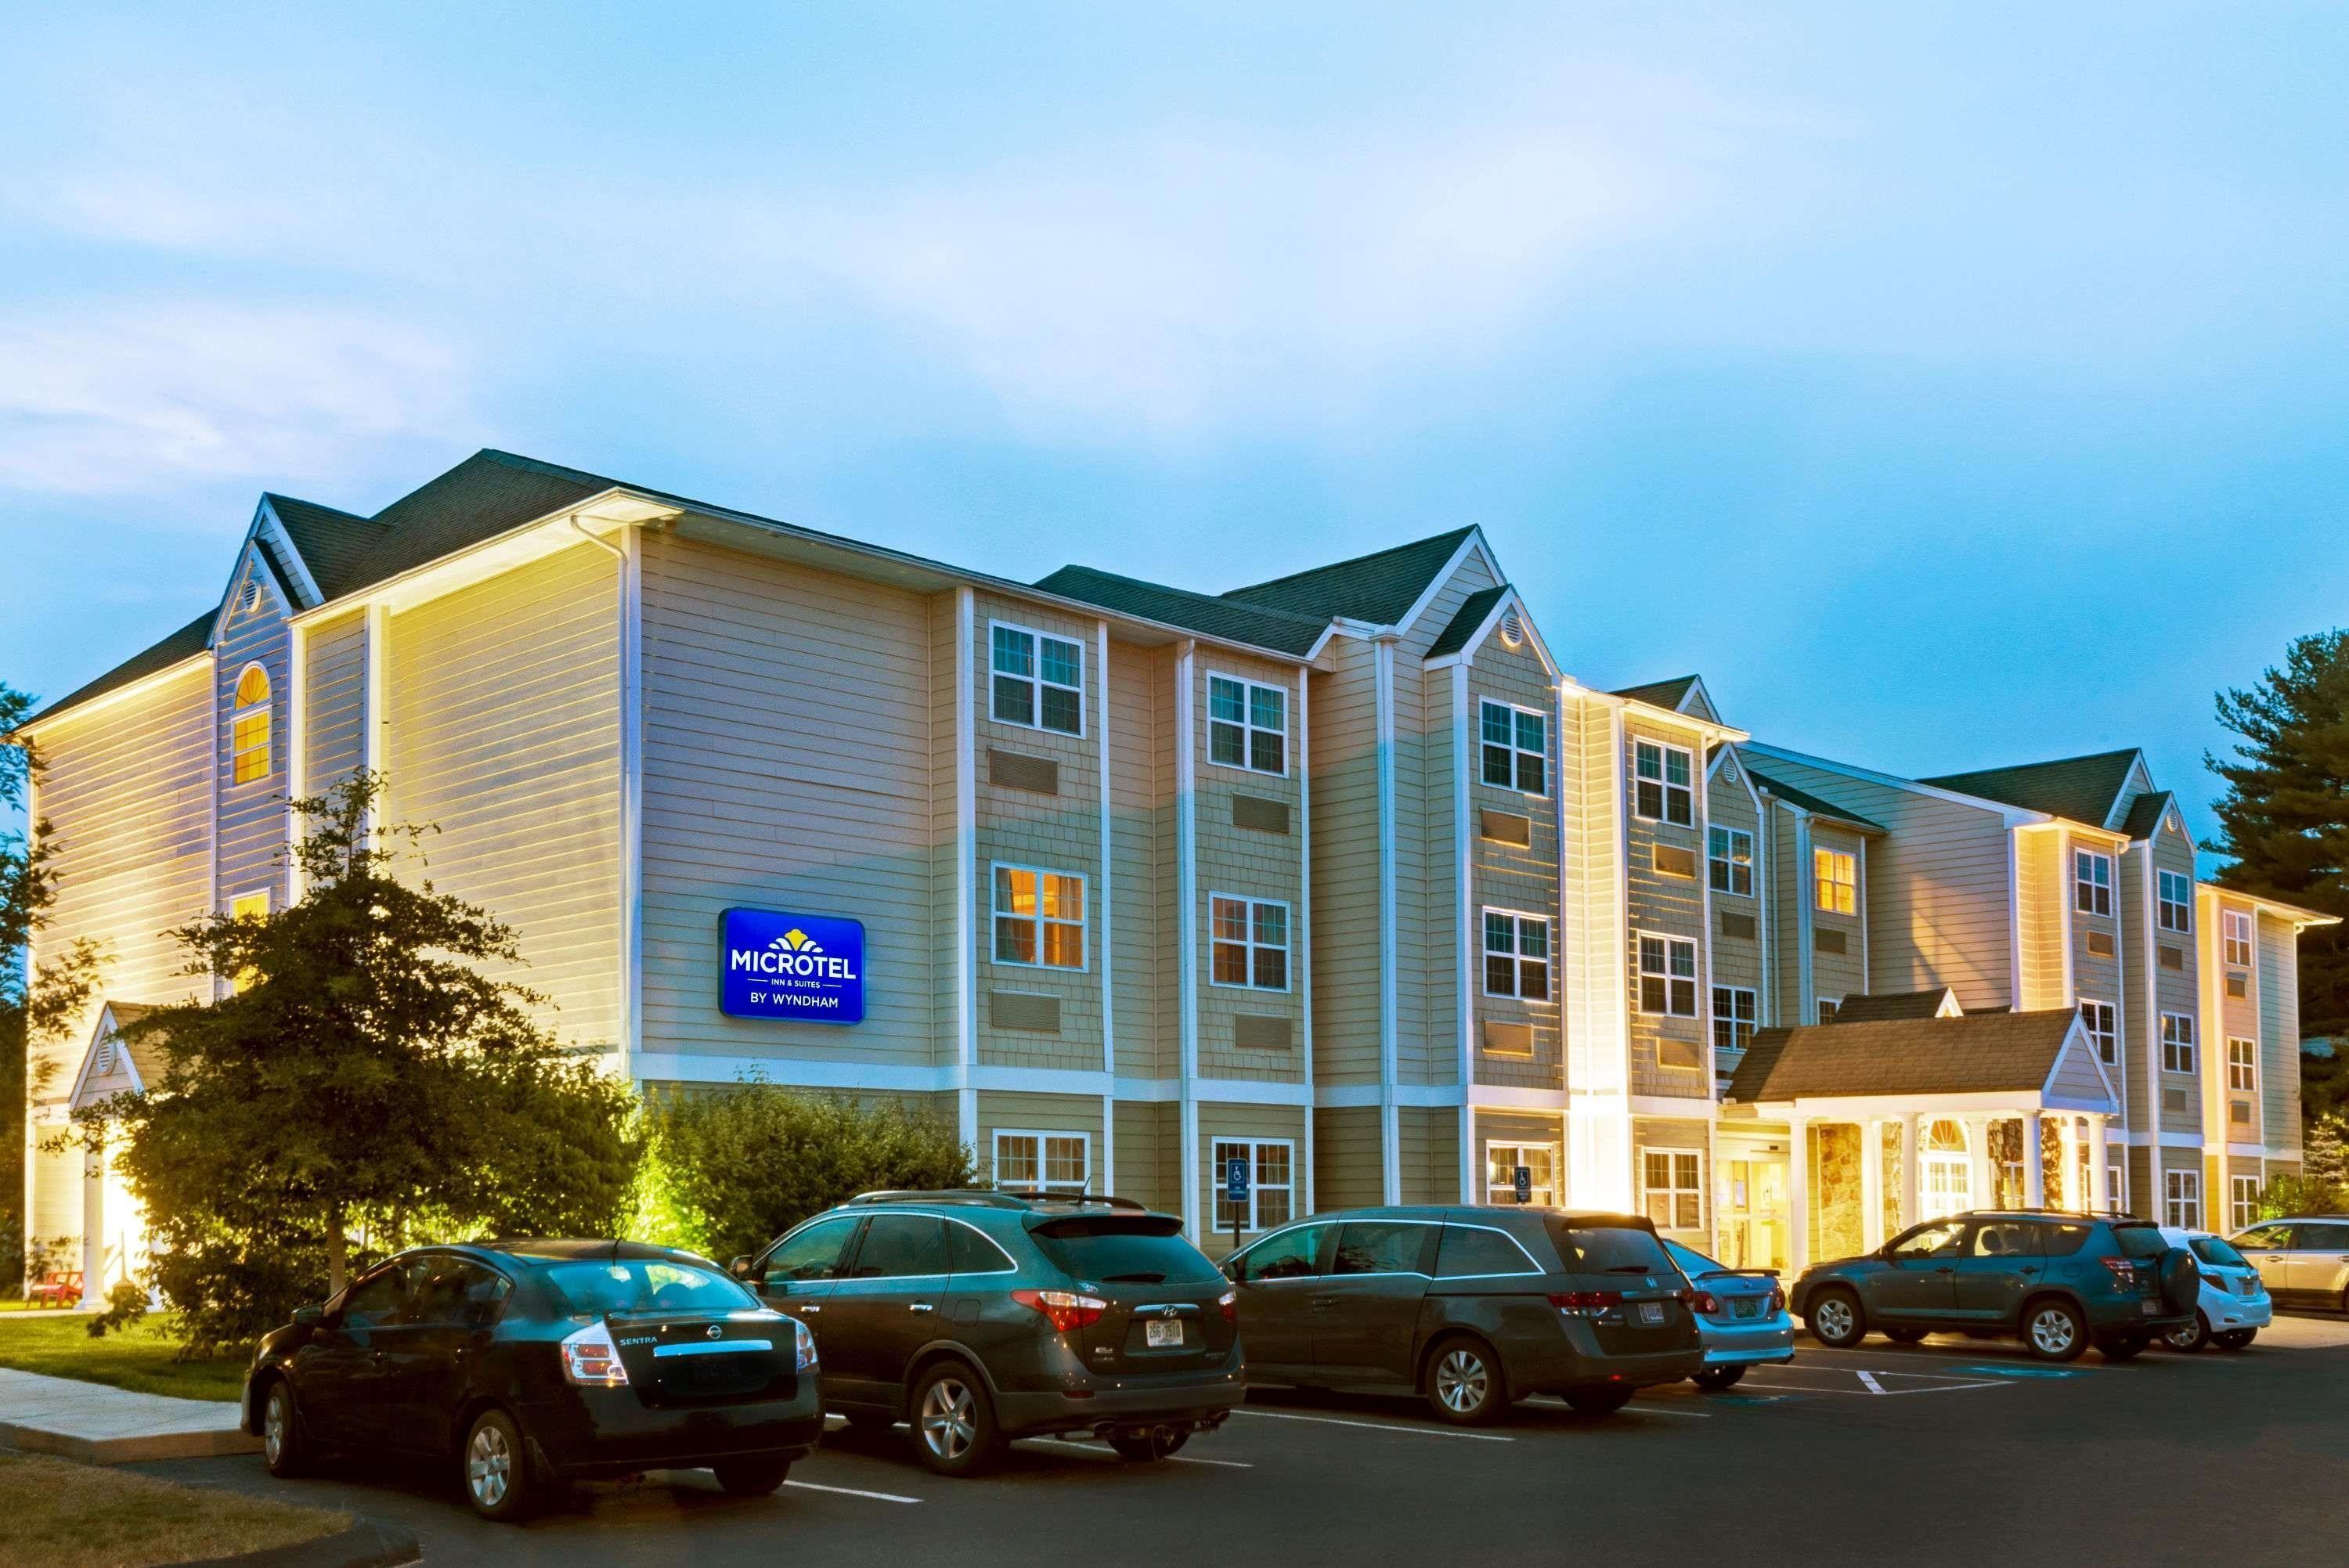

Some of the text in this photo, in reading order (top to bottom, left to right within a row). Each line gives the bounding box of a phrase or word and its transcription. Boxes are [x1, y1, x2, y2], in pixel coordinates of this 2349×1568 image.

[731, 950, 856, 979] MICROTEL
[750, 992, 839, 1008] BY WYNDHAM
[619, 1336, 658, 1346] SENTRA
